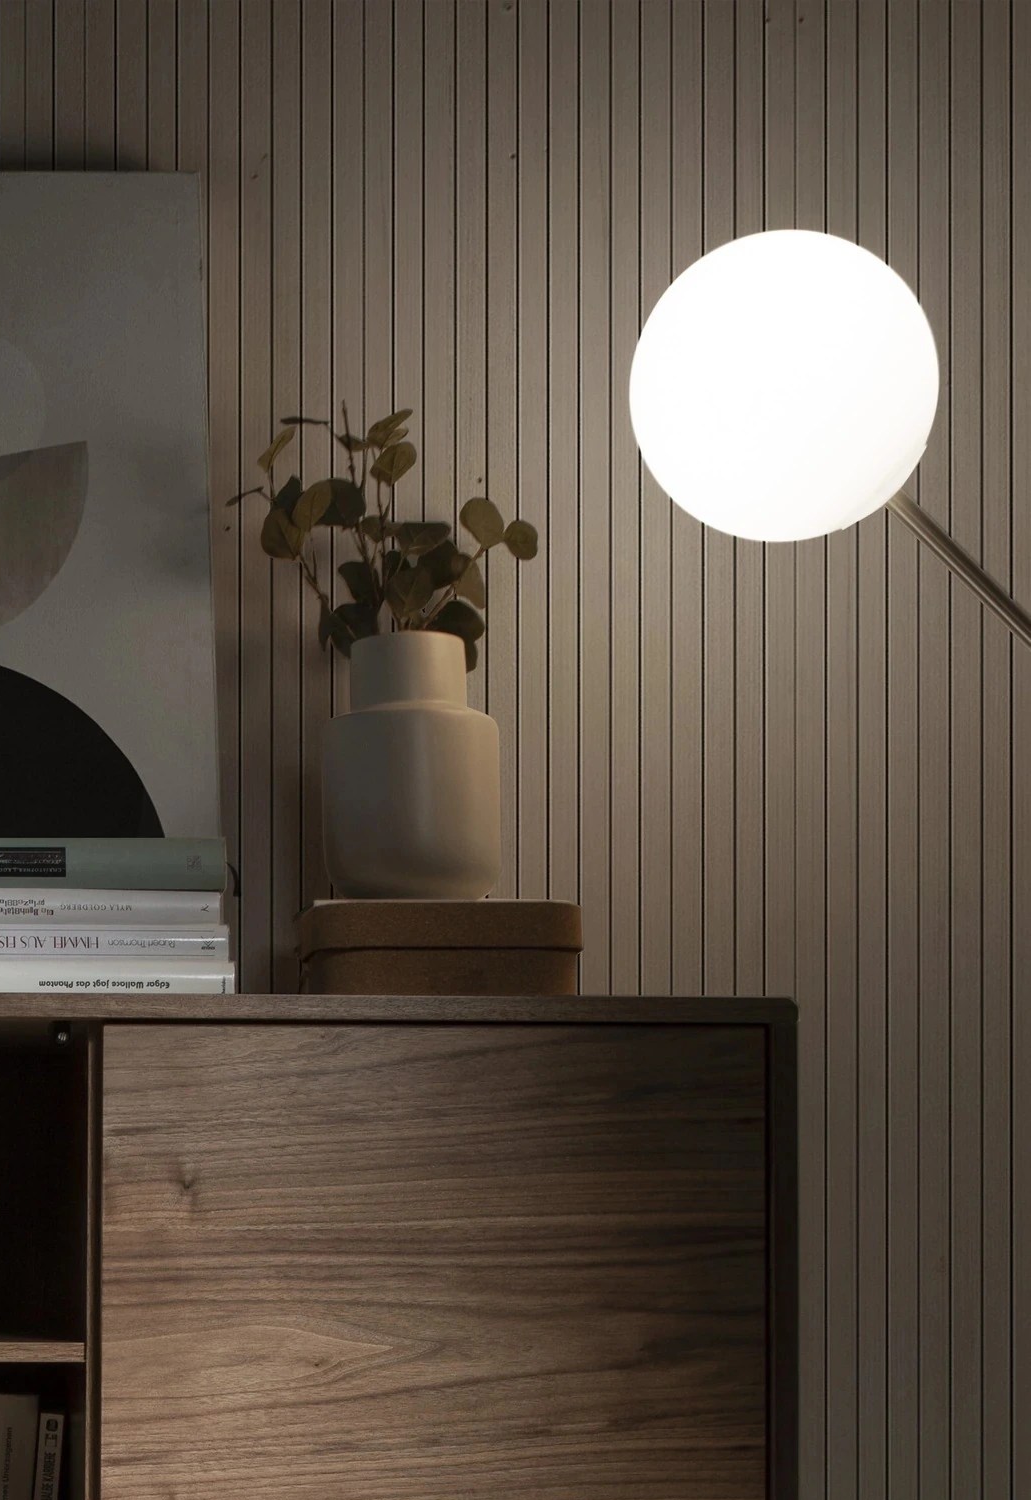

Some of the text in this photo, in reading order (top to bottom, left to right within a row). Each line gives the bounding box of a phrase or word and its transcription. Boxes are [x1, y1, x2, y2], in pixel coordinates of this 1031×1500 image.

[60, 903, 132, 911] MYLA GOLDBERG
[20, 936, 47, 949] AUS
[53, 936, 99, 949] HIMMEL
[107, 939, 176, 949] Rupert Thomson
[38, 979, 170, 990] Edgar Wallace jagt das Phantom
